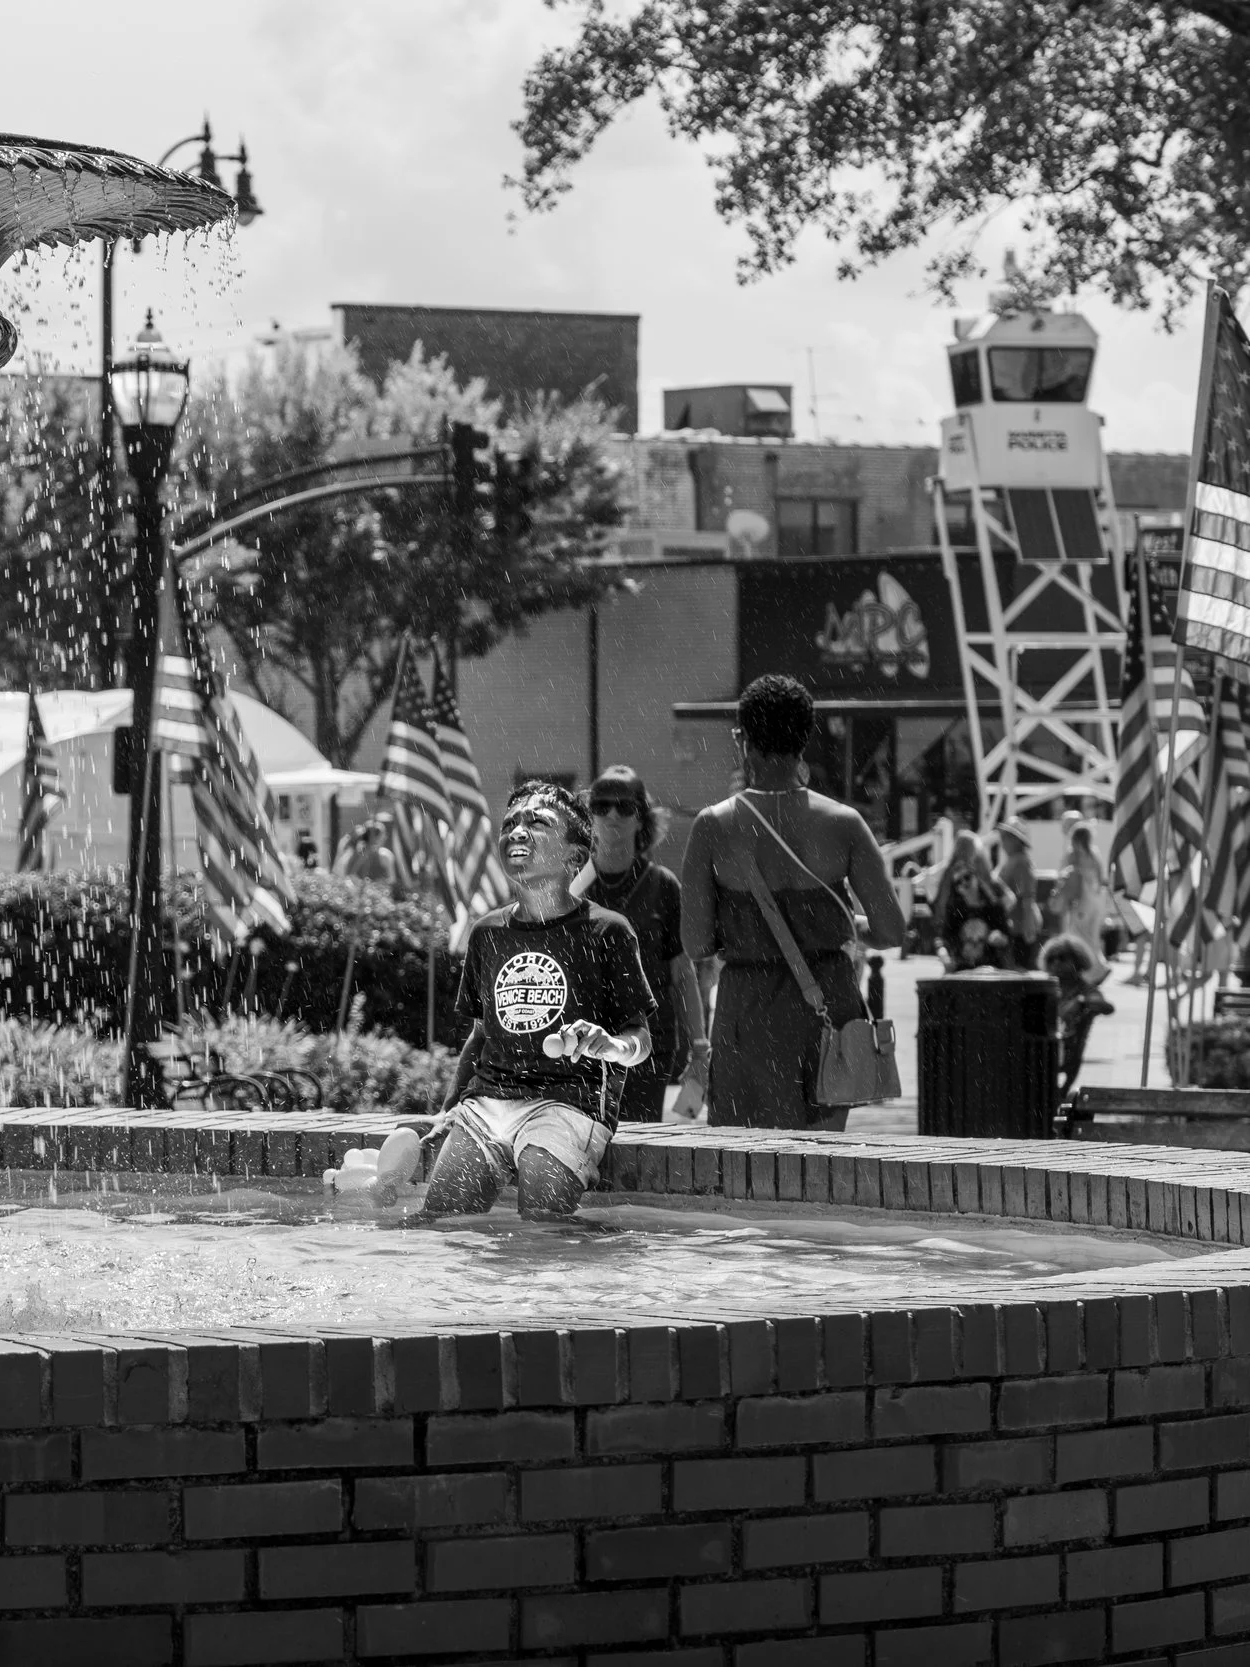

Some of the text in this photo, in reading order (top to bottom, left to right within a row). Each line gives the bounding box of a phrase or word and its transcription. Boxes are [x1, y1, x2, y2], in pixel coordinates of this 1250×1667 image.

[1007, 438, 1068, 451] POLICE
[823, 601, 926, 651] MPC
[498, 954, 562, 985] FLORIDA
[497, 988, 563, 1007] VENICE BEACH
[502, 1013, 550, 1030] EST. 1927
